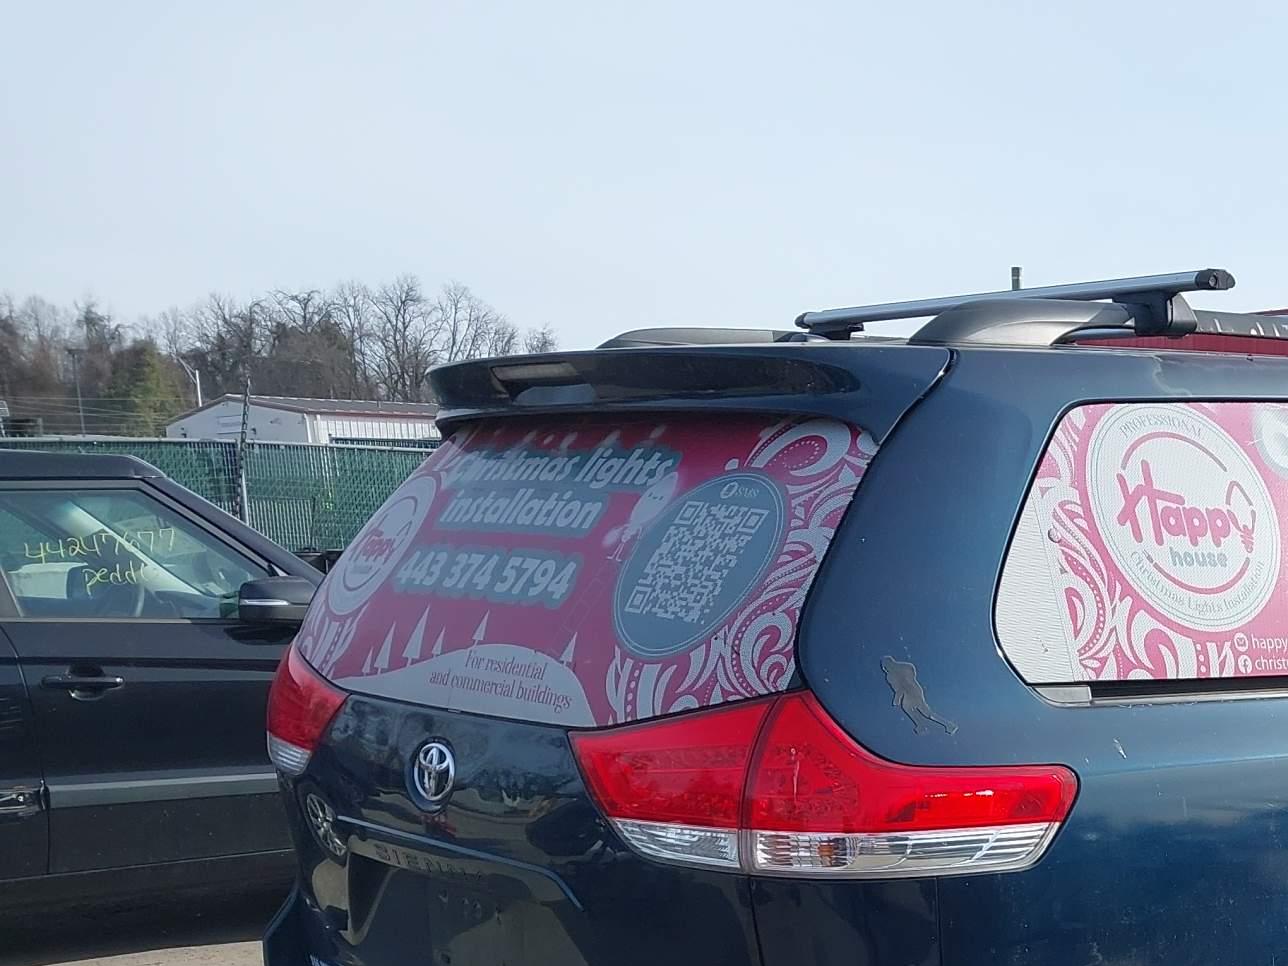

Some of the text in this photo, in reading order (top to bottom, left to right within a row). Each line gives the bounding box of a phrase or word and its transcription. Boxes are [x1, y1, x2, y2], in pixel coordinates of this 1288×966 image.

[452, 447, 673, 488] Christmas lights
[440, 488, 602, 528] installation
[1116, 459, 1256, 553] Happy
[397, 551, 577, 599] 443 374 5794
[1168, 547, 1228, 567] house
[1187, 598, 1224, 616] Lights
[465, 650, 548, 681] For residential
[429, 667, 572, 713] and commercial buildings
